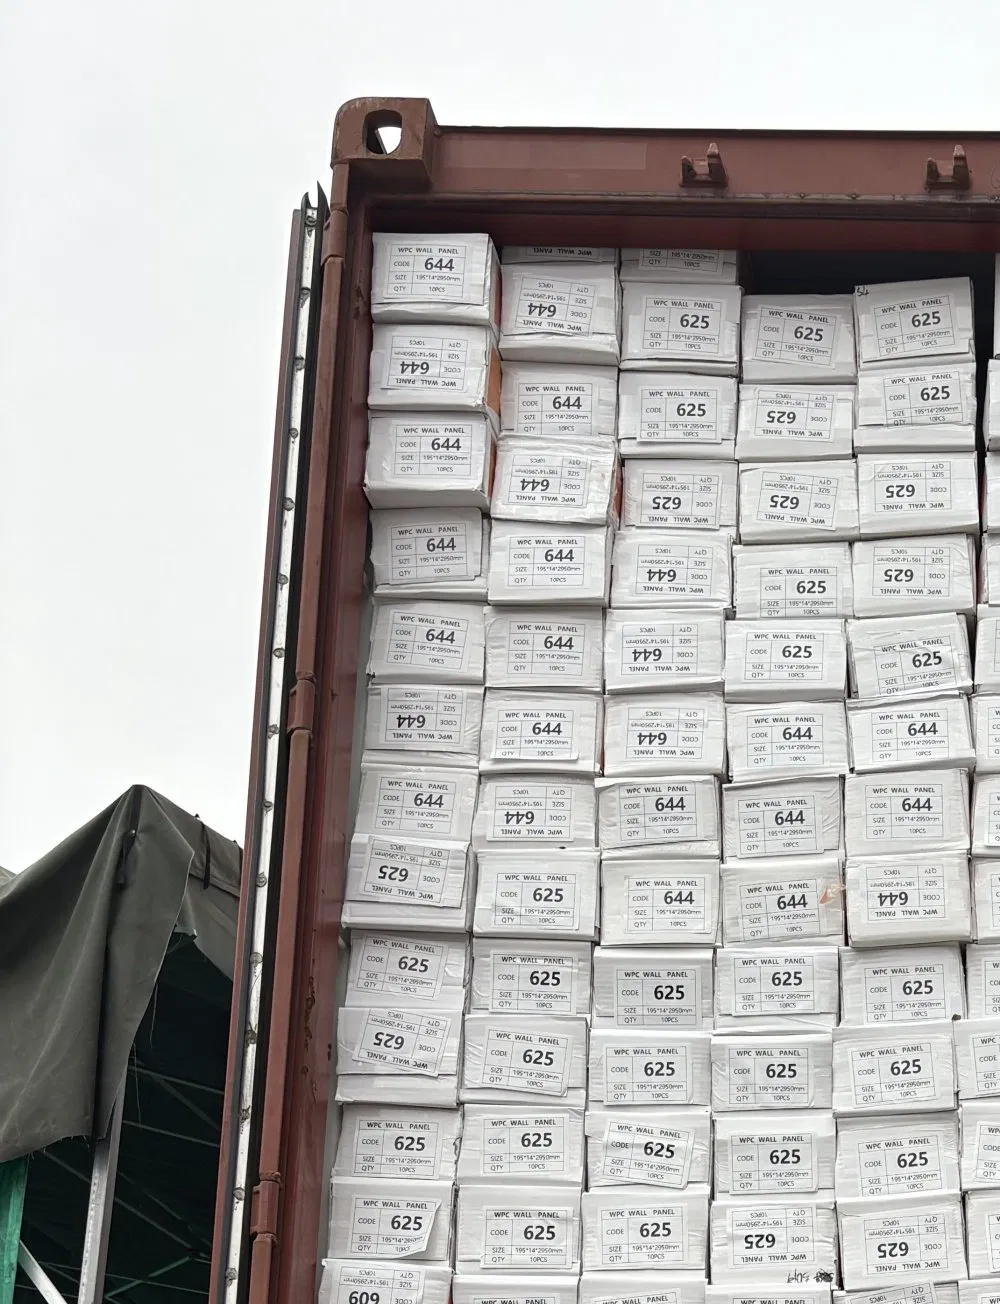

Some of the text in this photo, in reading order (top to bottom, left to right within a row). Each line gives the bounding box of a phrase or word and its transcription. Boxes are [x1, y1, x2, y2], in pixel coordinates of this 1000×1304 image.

[912, 311, 940, 327] 625
[677, 403, 706, 417] 625
[545, 549, 574, 562] 644
[647, 569, 676, 582] 644
[396, 715, 425, 728] 644
[902, 798, 933, 812] 644
[533, 888, 563, 902] 625
[654, 985, 684, 1000] 625
[373, 1032, 404, 1050] 625
[766, 1064, 797, 1078] 625
[770, 1149, 800, 1164] 625
